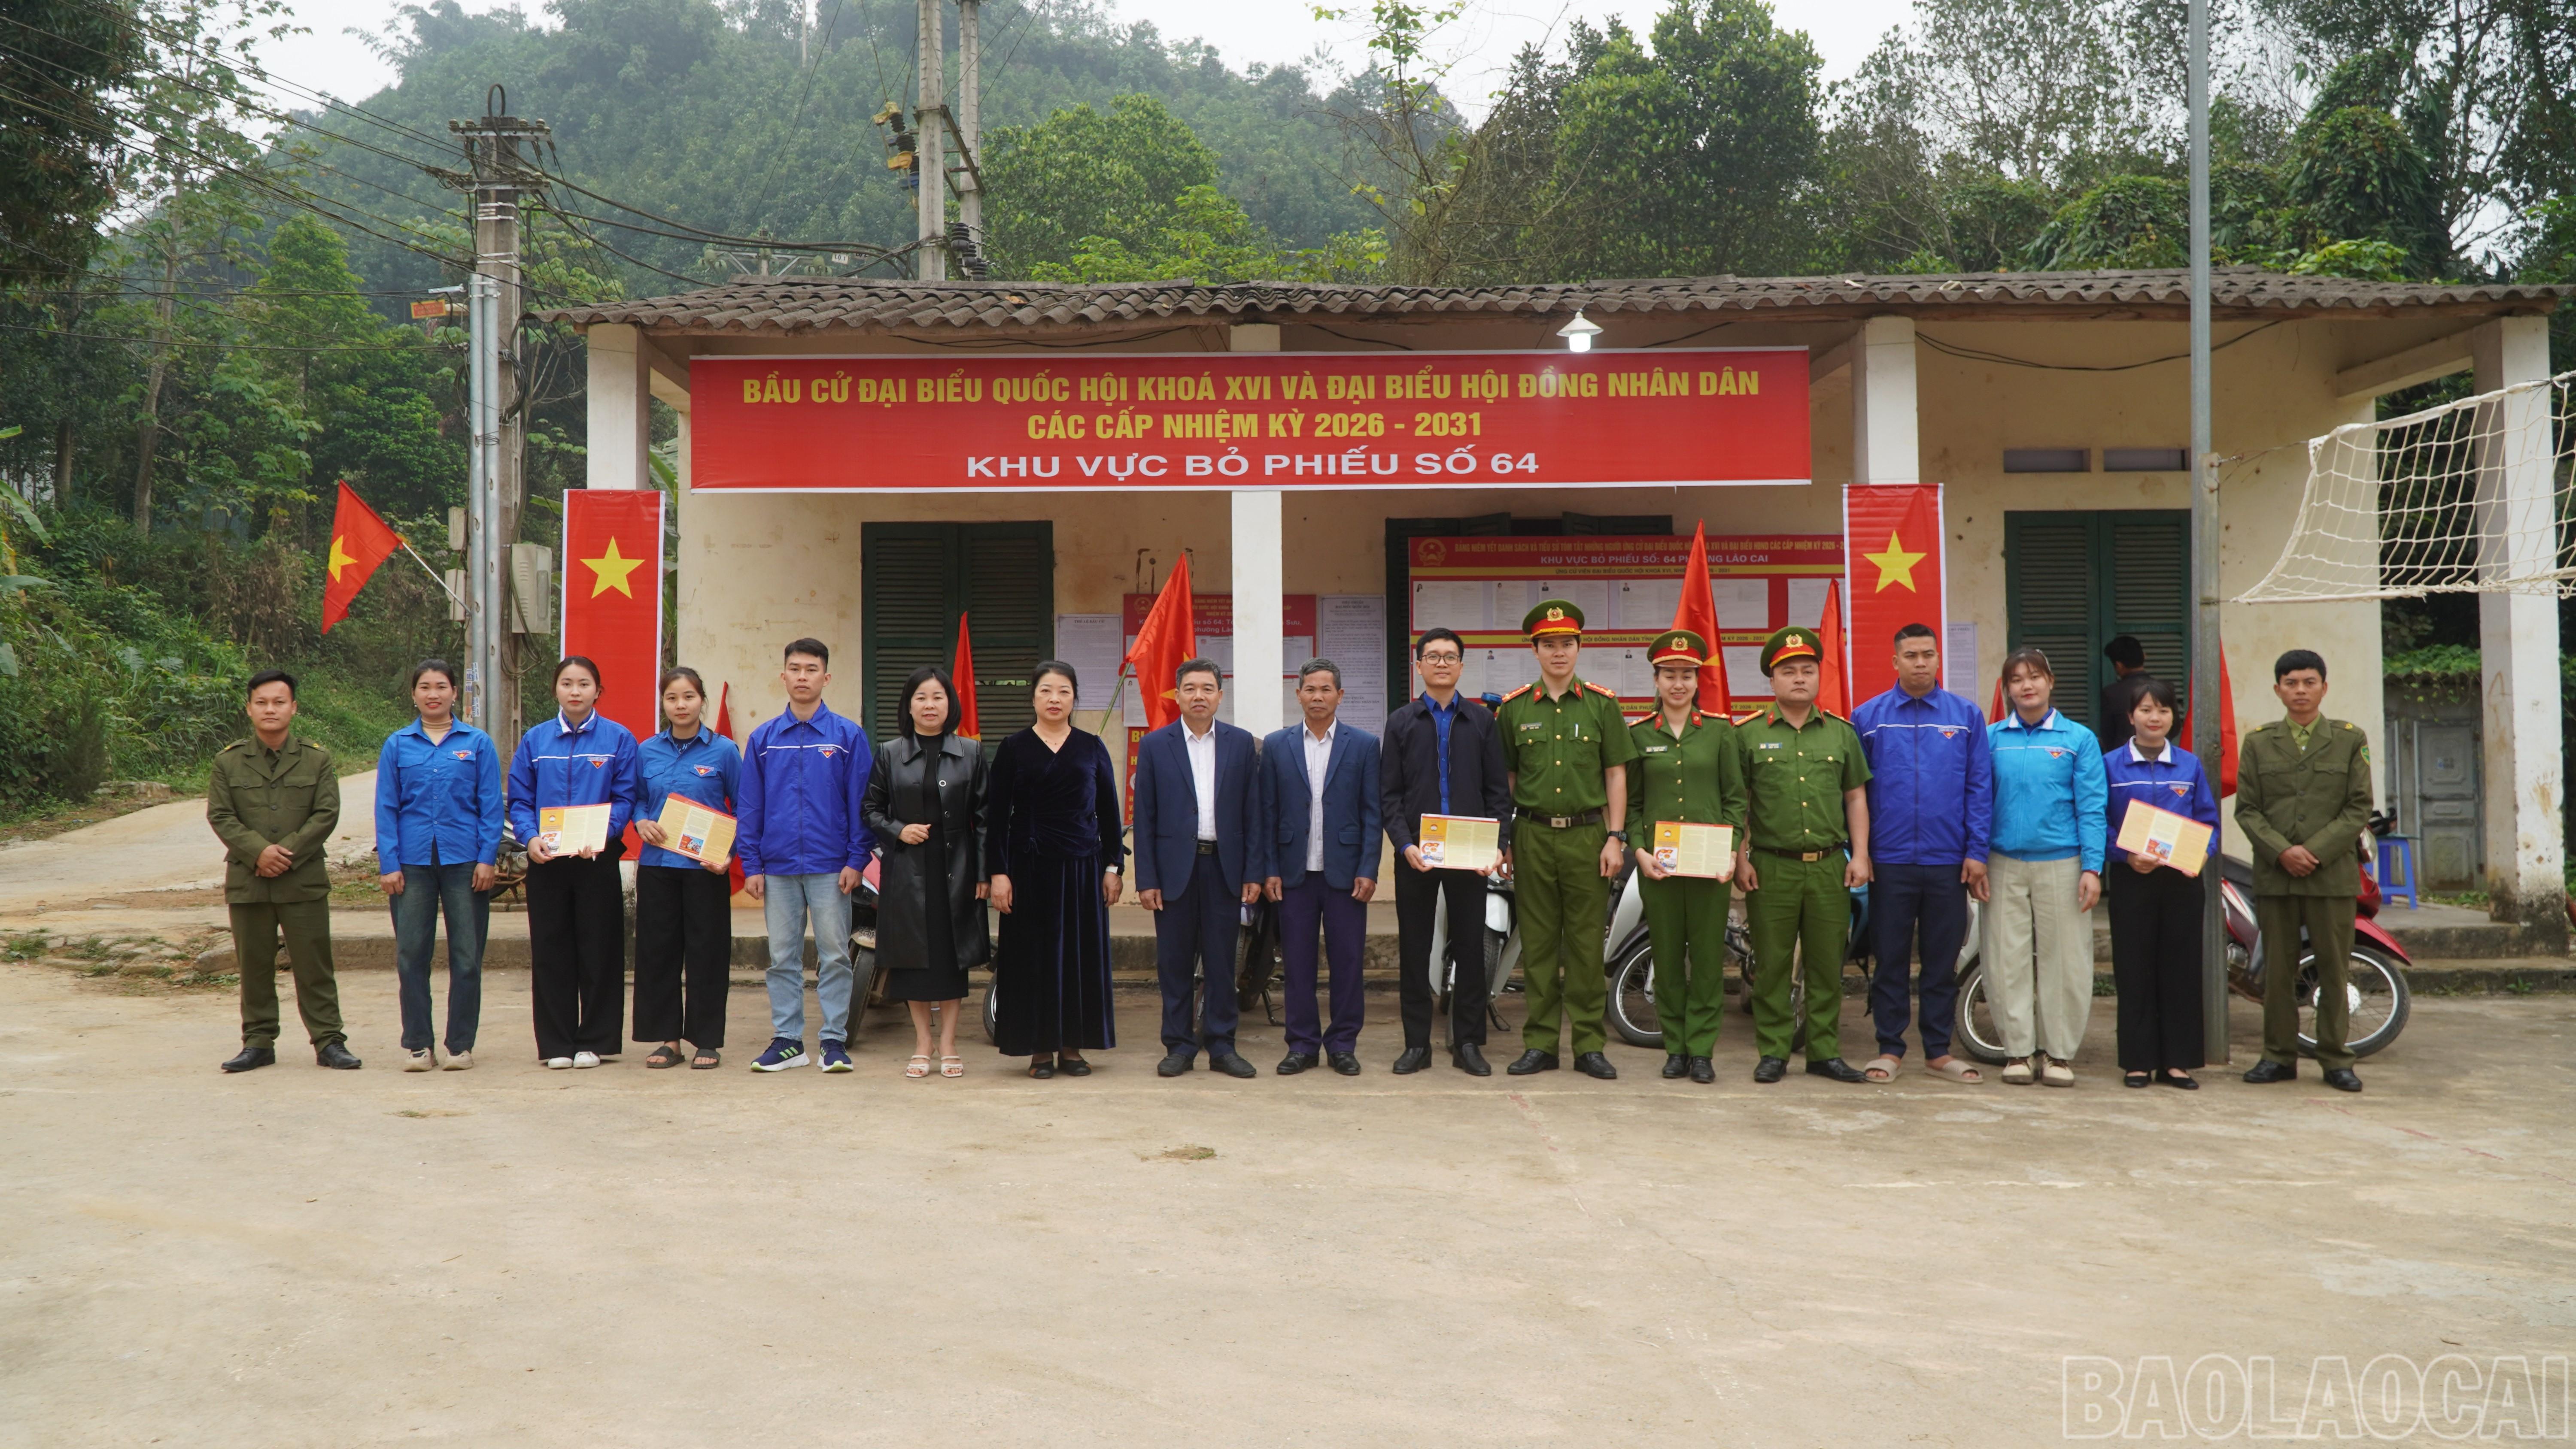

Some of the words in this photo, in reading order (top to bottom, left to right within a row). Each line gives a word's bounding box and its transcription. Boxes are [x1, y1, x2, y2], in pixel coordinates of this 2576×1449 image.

[743, 370, 801, 403] BẦU
[811, 370, 853, 403] CỬ
[858, 378, 906, 408] ĐẠI
[917, 368, 982, 402] BIỂU
[993, 369, 1069, 404] QUỐC
[1080, 372, 1127, 406] HỘI
[1138, 371, 1216, 400] KHOÁ
[1225, 376, 1271, 400] XVI
[1281, 371, 1318, 400] VÀ
[1327, 375, 1375, 404] ĐẠI
[1385, 365, 1451, 399] BIỂU
[1461, 369, 1509, 403] HỘI
[1518, 366, 1598, 397] ĐỒNG
[1608, 367, 1689, 397] NHÂN
[1699, 366, 1759, 395] DÂN
[1027, 410, 1086, 440] CÁC
[1095, 406, 1153, 439] CẤP
[1163, 409, 1258, 443] NHIỆM
[1268, 408, 1305, 437] KỲ
[1314, 412, 1385, 437] 2026
[1414, 412, 1481, 437] 2031
[967, 456, 1060, 478] KHU
[1075, 452, 1169, 482] VỰC
[1185, 446, 1250, 476] BỎ
[1264, 445, 1399, 476] PHIẾU
[1414, 443, 1477, 475] SỐ
[1490, 452, 1540, 474] 64
[1566, 555, 1588, 566] VỰC
[1591, 553, 1606, 564] BỎ
[1608, 552, 1639, 564] PHIẾU
[1726, 553, 1747, 563] LÀO
[1750, 555, 1768, 563] CAI
